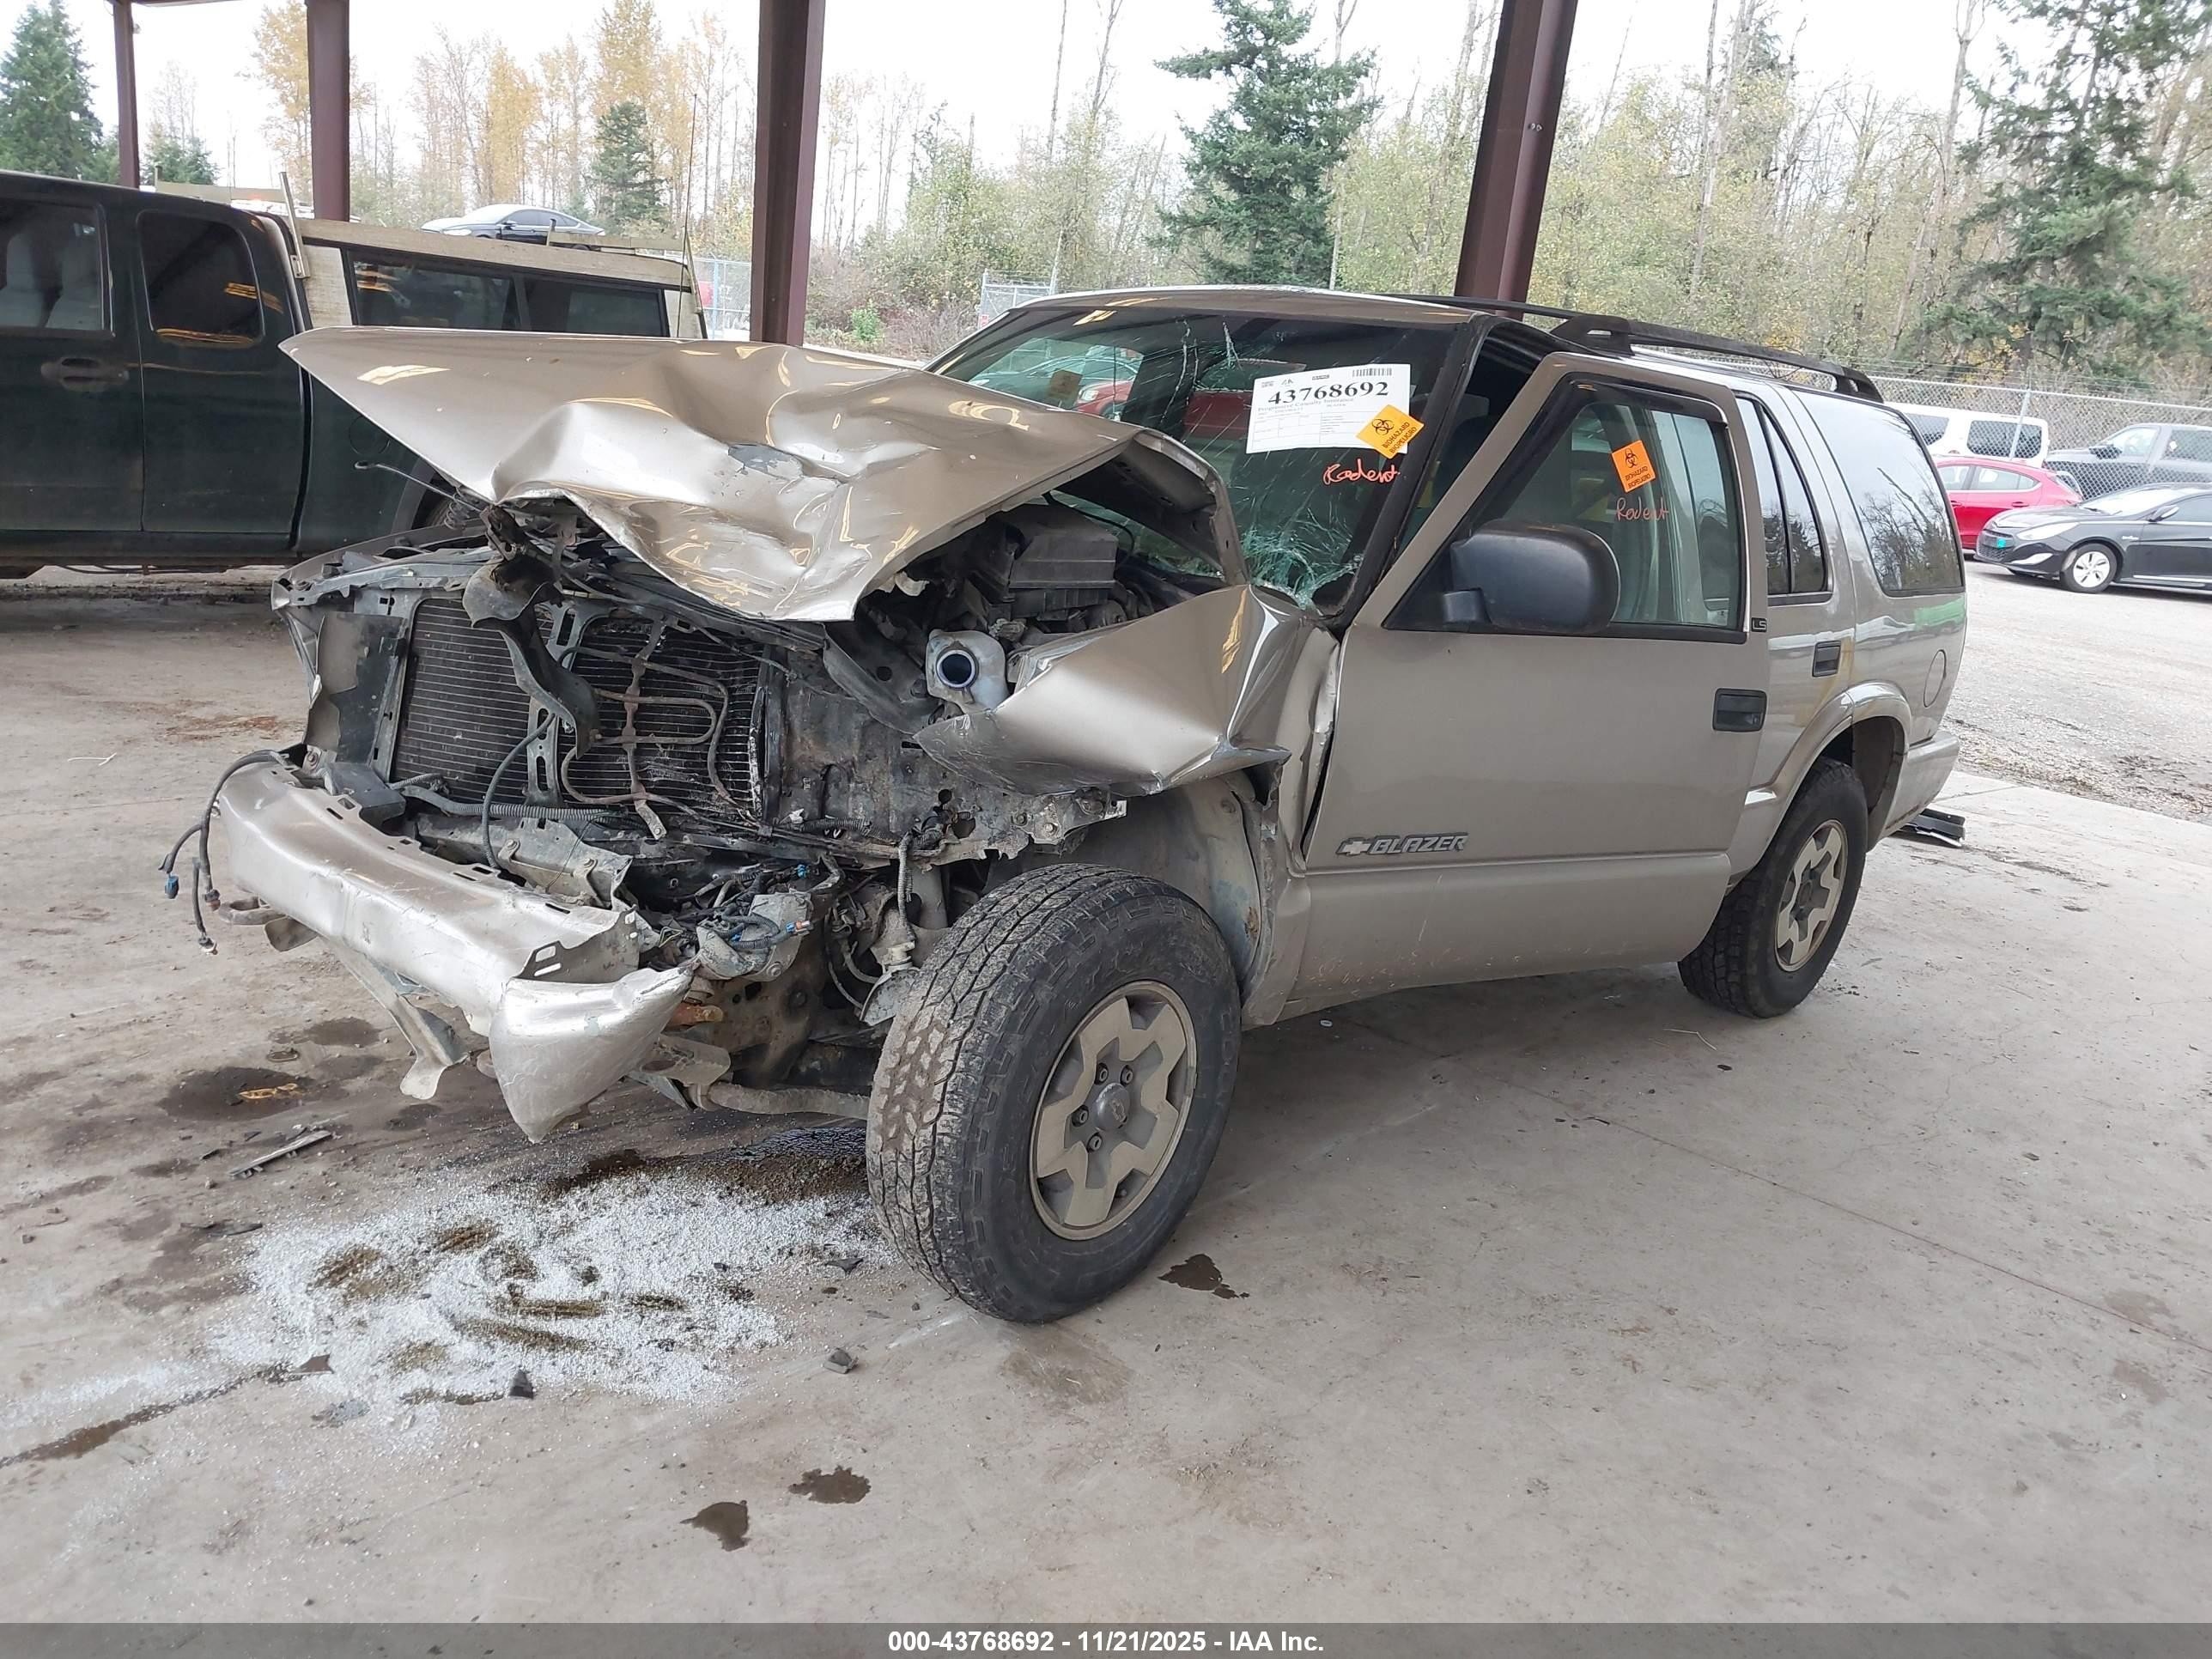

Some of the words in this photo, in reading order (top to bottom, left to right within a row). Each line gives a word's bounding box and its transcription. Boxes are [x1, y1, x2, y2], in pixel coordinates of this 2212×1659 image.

[1267, 381, 1389, 404] 43768692
[1382, 422, 1411, 450] BIOHAZARD
[1752, 619, 1767, 630] LS
[1369, 834, 1469, 854] BLAZER
